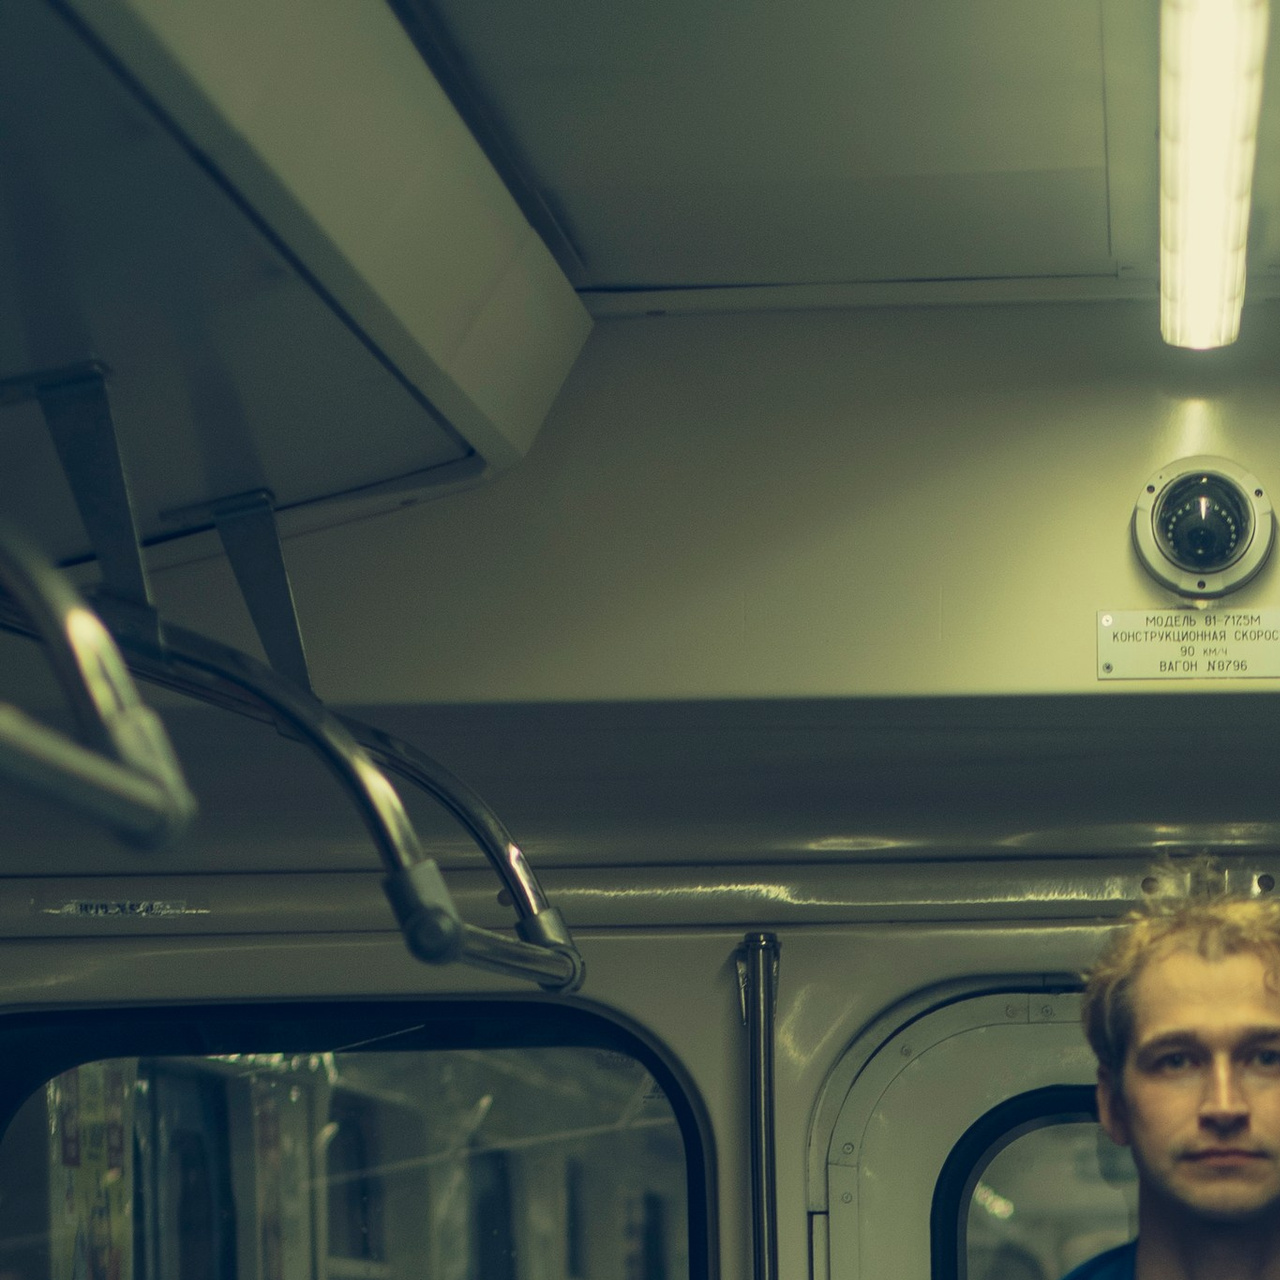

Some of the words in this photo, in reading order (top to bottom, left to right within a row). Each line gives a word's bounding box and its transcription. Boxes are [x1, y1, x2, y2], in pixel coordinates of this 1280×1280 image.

[1145, 615, 1197, 628] МОДЕЛЬ
[1112, 629, 1227, 643] КОНСТРУКЦИОННАЯ
[1180, 645, 1195, 657] 90
[1159, 660, 1198, 672] ВАГОН
